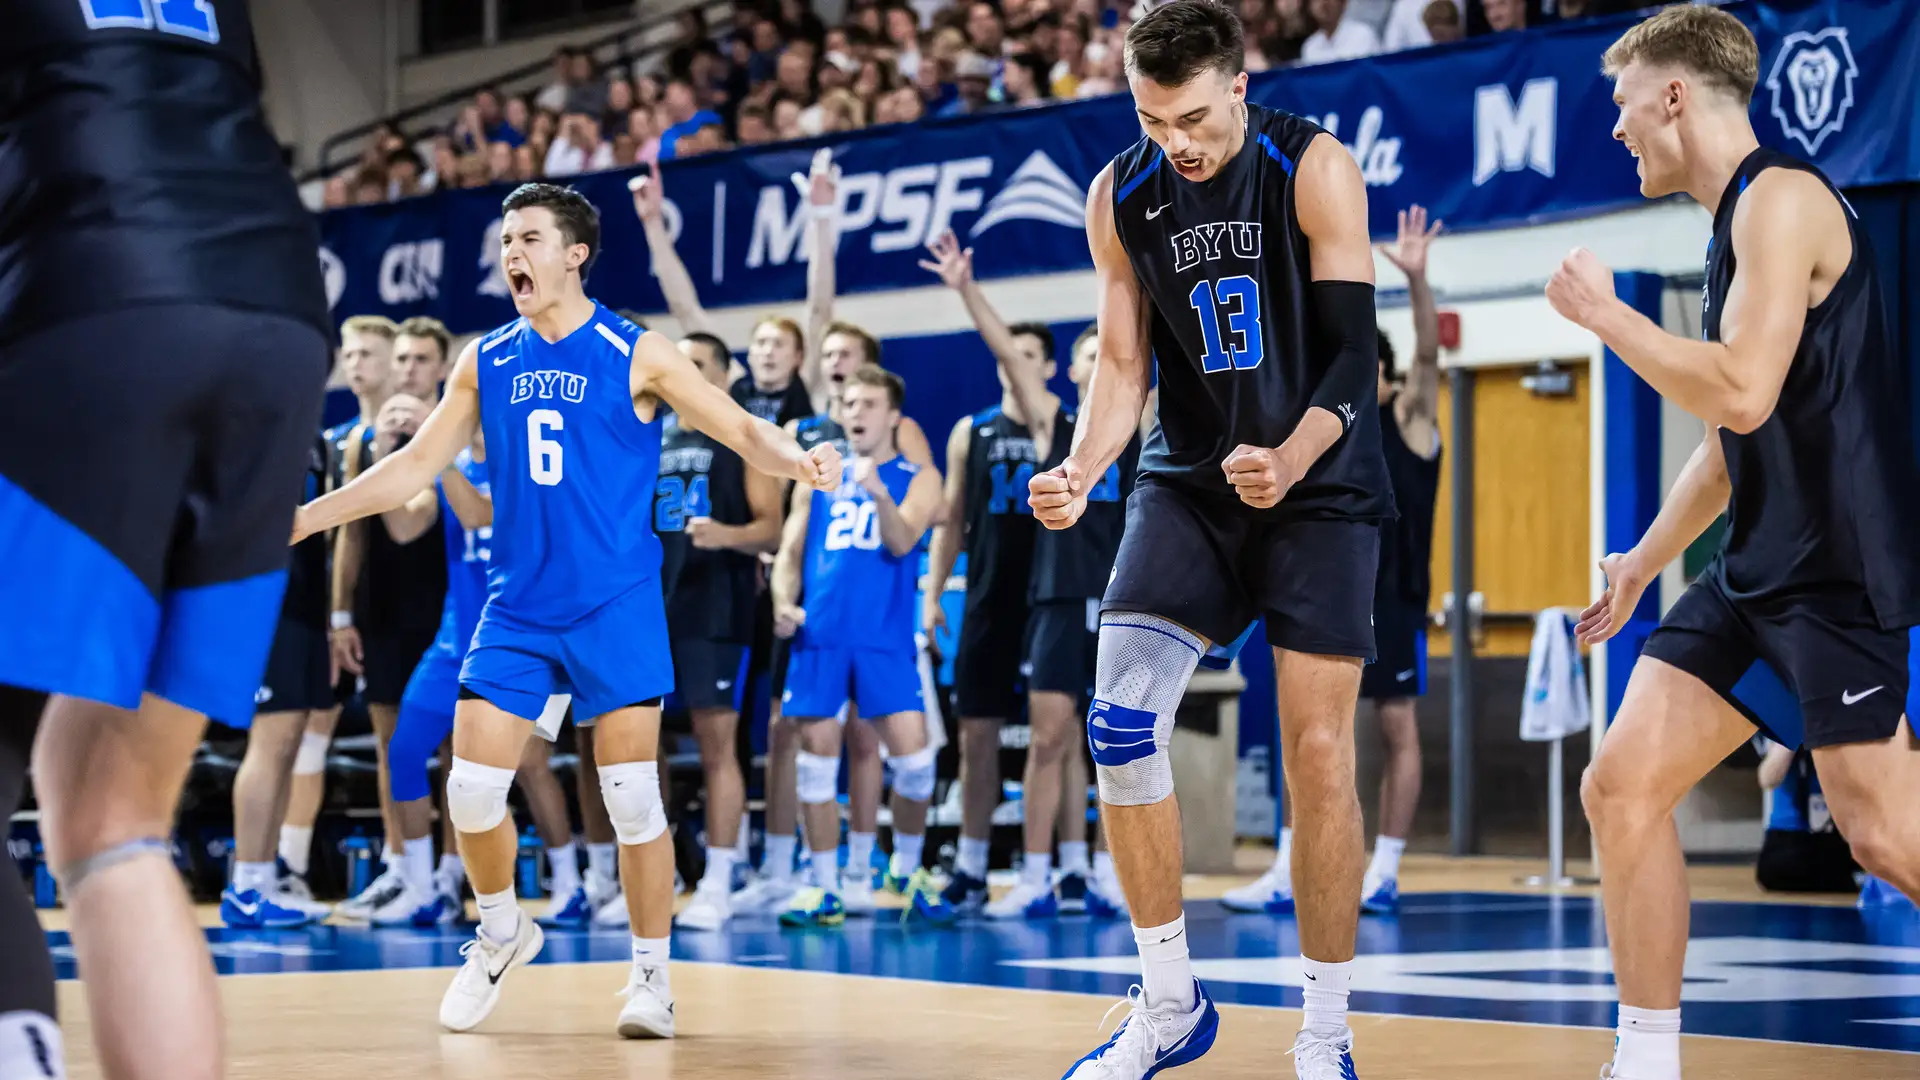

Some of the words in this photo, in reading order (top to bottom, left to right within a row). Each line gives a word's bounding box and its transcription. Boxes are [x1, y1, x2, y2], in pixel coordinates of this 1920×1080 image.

[1472, 76, 1558, 187] M
[745, 156, 993, 269] MPSF
[1171, 221, 1262, 273] BYU
[1189, 274, 1264, 374] 13
[510, 369, 588, 405] BYU
[527, 408, 564, 487] 6
[659, 447, 713, 475] BYU
[655, 473, 712, 532] 24
[824, 500, 883, 551] 20
